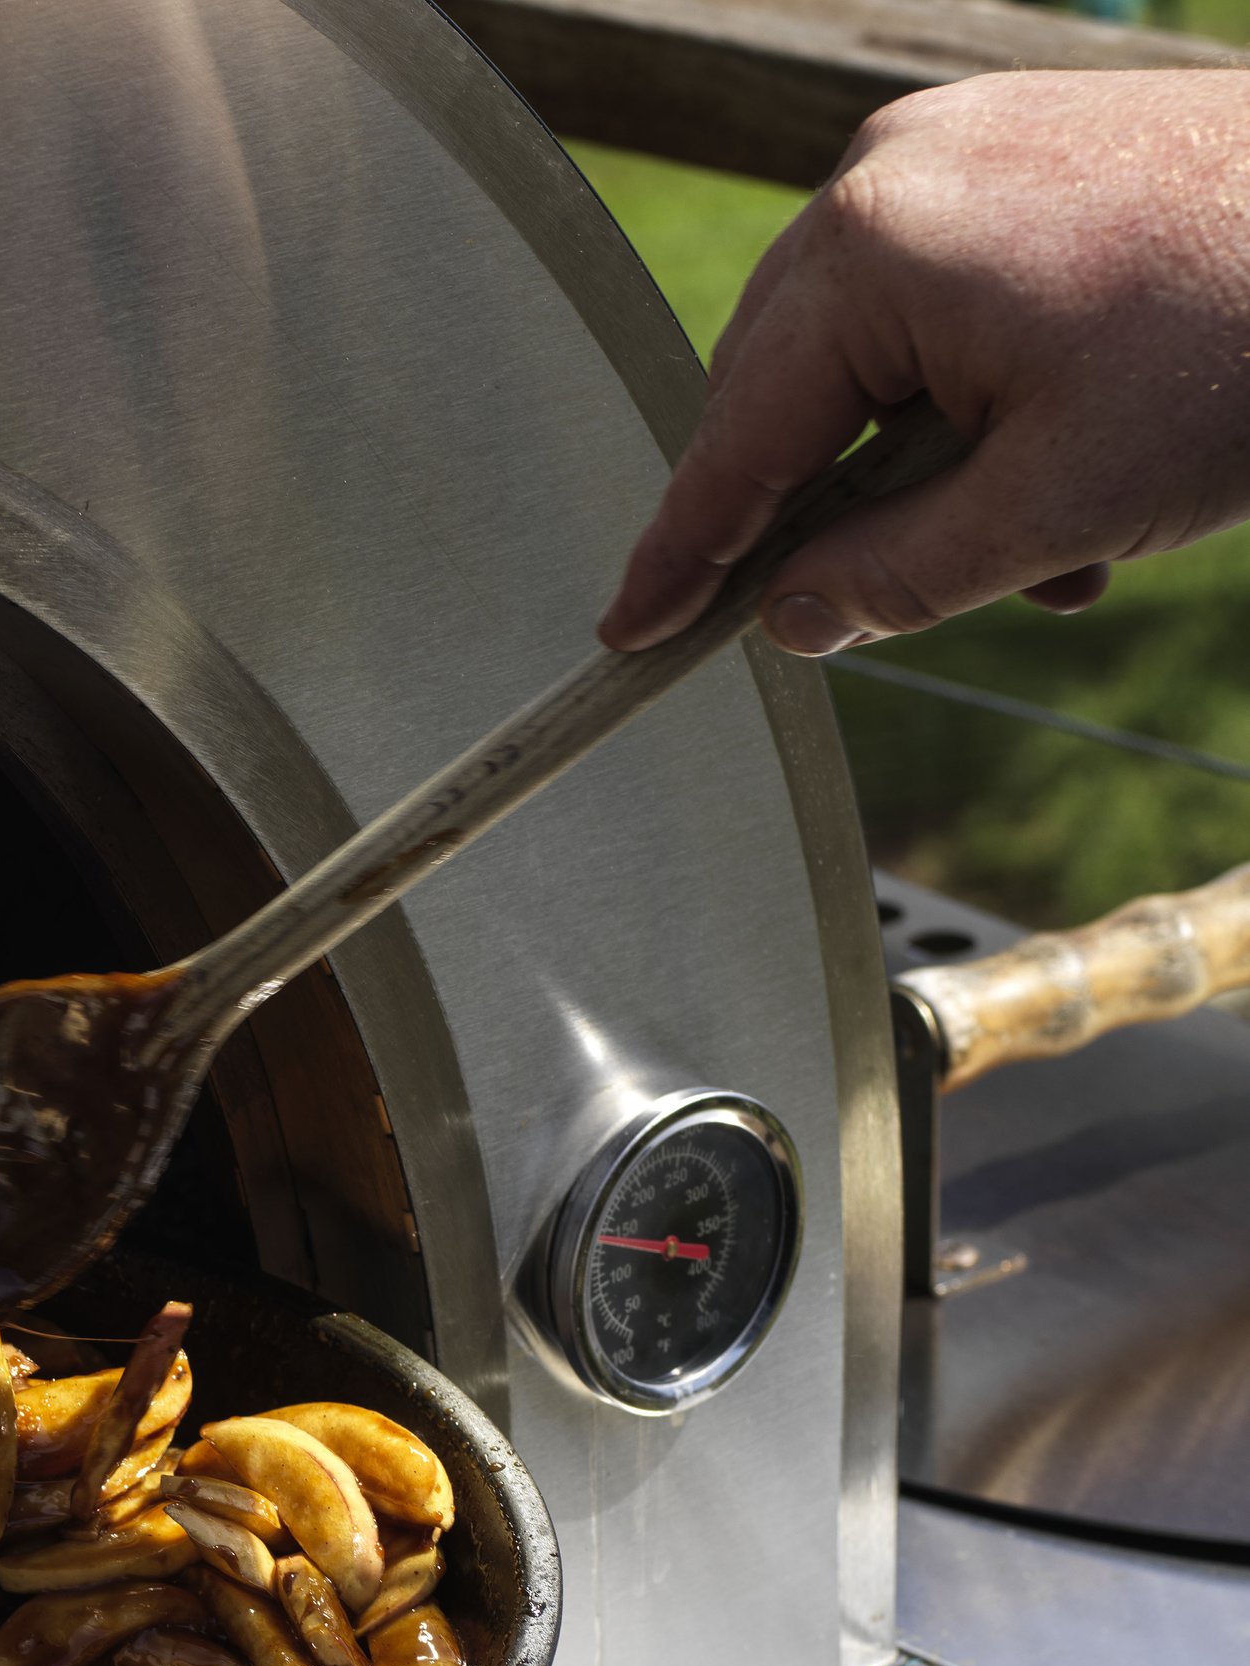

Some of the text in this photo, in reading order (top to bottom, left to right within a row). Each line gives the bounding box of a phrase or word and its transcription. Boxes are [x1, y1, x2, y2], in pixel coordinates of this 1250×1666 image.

[664, 1167, 688, 1189] 250
[630, 1185, 656, 1208] 200
[685, 1183, 709, 1204] 300
[615, 1219, 638, 1238] 150
[696, 1214, 720, 1238] 350
[610, 1264, 632, 1283] 100
[687, 1258, 712, 1276] 400
[625, 1294, 641, 1313] 50
[612, 1345, 634, 1366] 100
